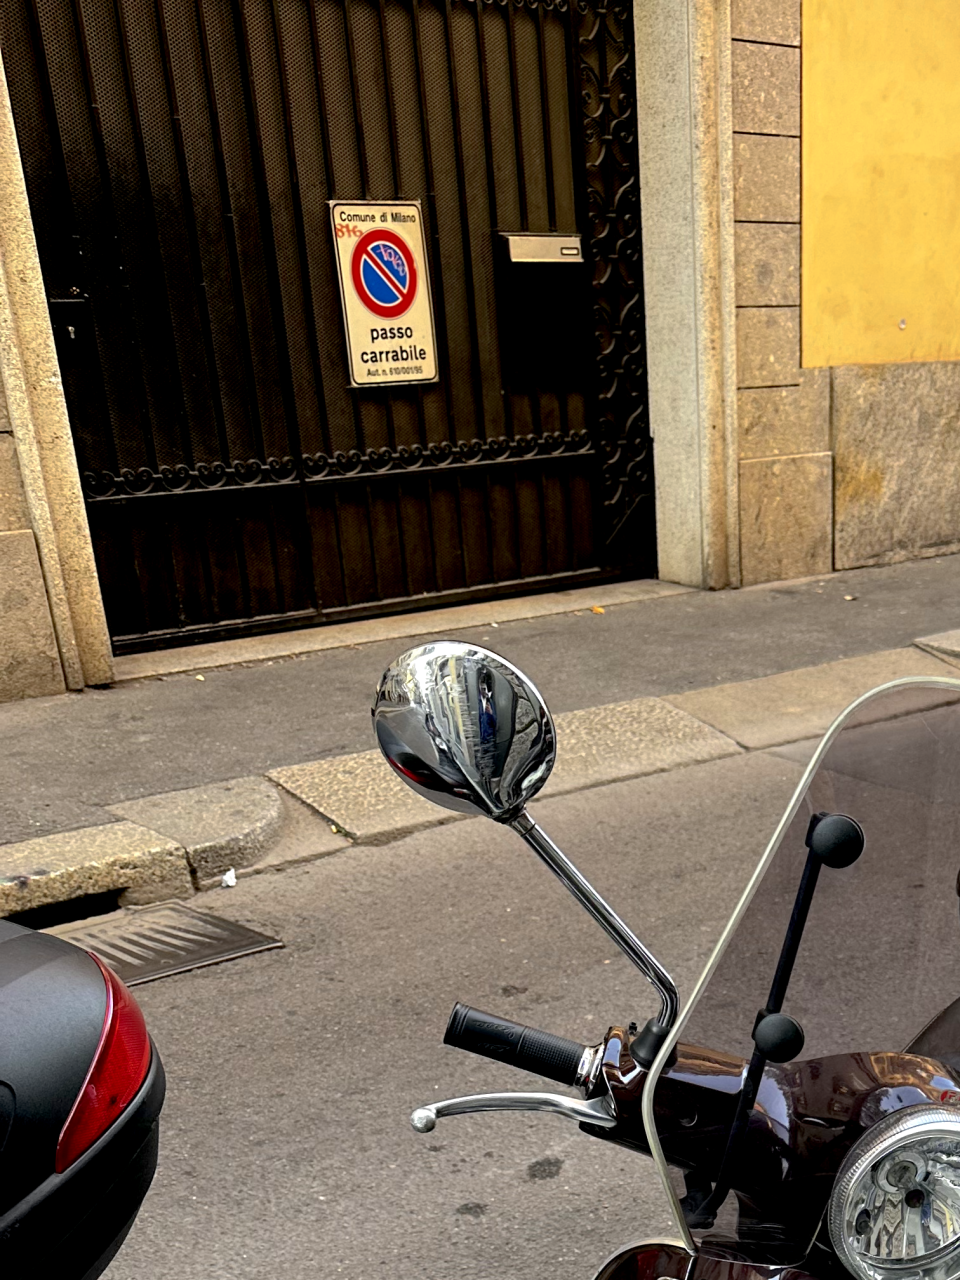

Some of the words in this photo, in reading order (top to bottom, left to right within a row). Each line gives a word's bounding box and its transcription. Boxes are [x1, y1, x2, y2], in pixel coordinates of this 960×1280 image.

[340, 211, 376, 223] Comune
[380, 212, 388, 223] di
[391, 212, 417, 223] Milano
[370, 326, 413, 343] passo
[360, 345, 427, 364] carrabile
